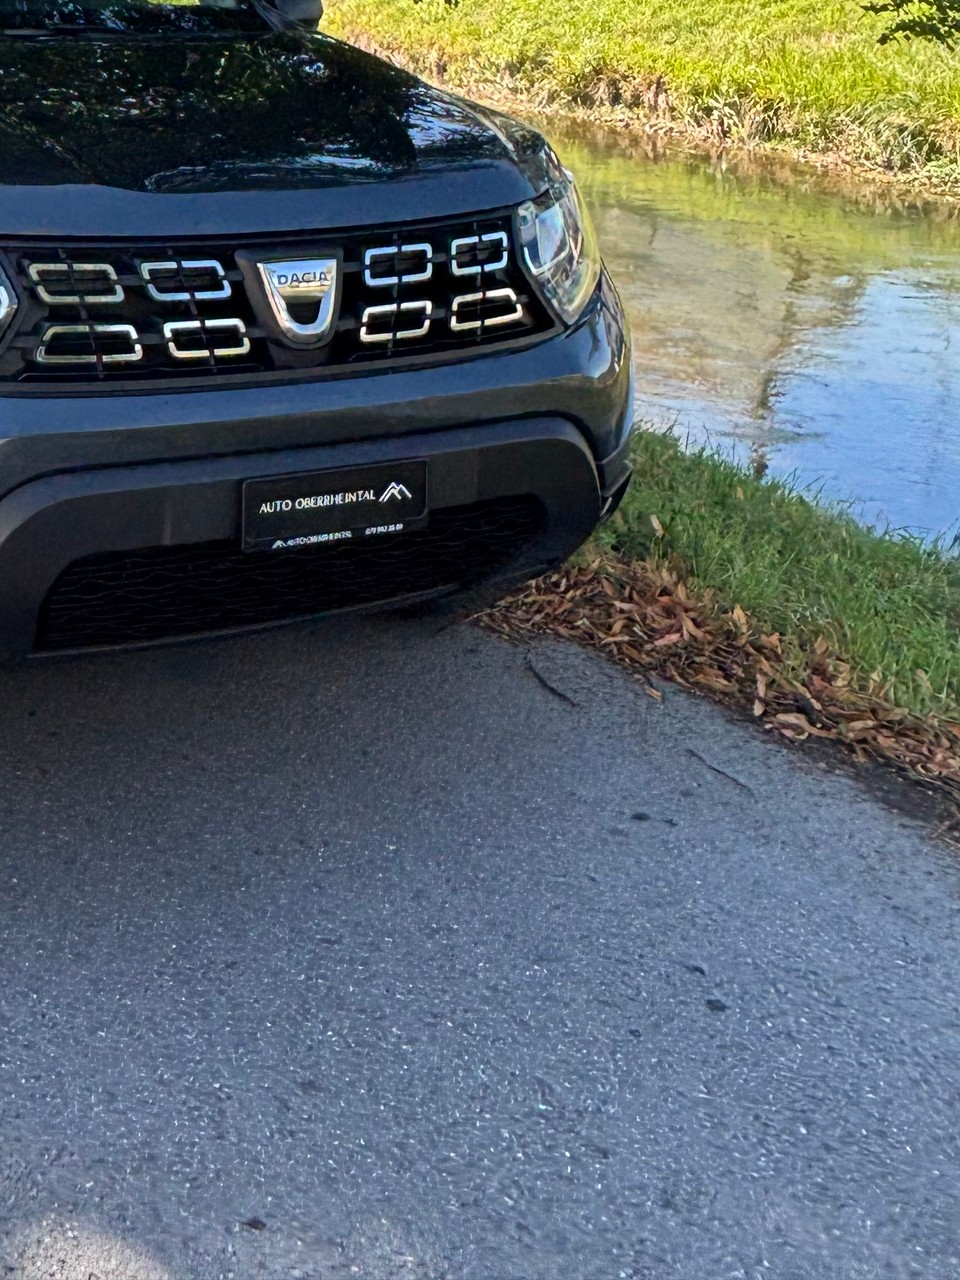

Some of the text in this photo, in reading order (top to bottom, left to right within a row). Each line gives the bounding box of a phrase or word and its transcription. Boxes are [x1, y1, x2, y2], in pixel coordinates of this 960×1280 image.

[277, 271, 329, 285] DACIA
[259, 490, 376, 514] AUTO OBERRHEINTAL
